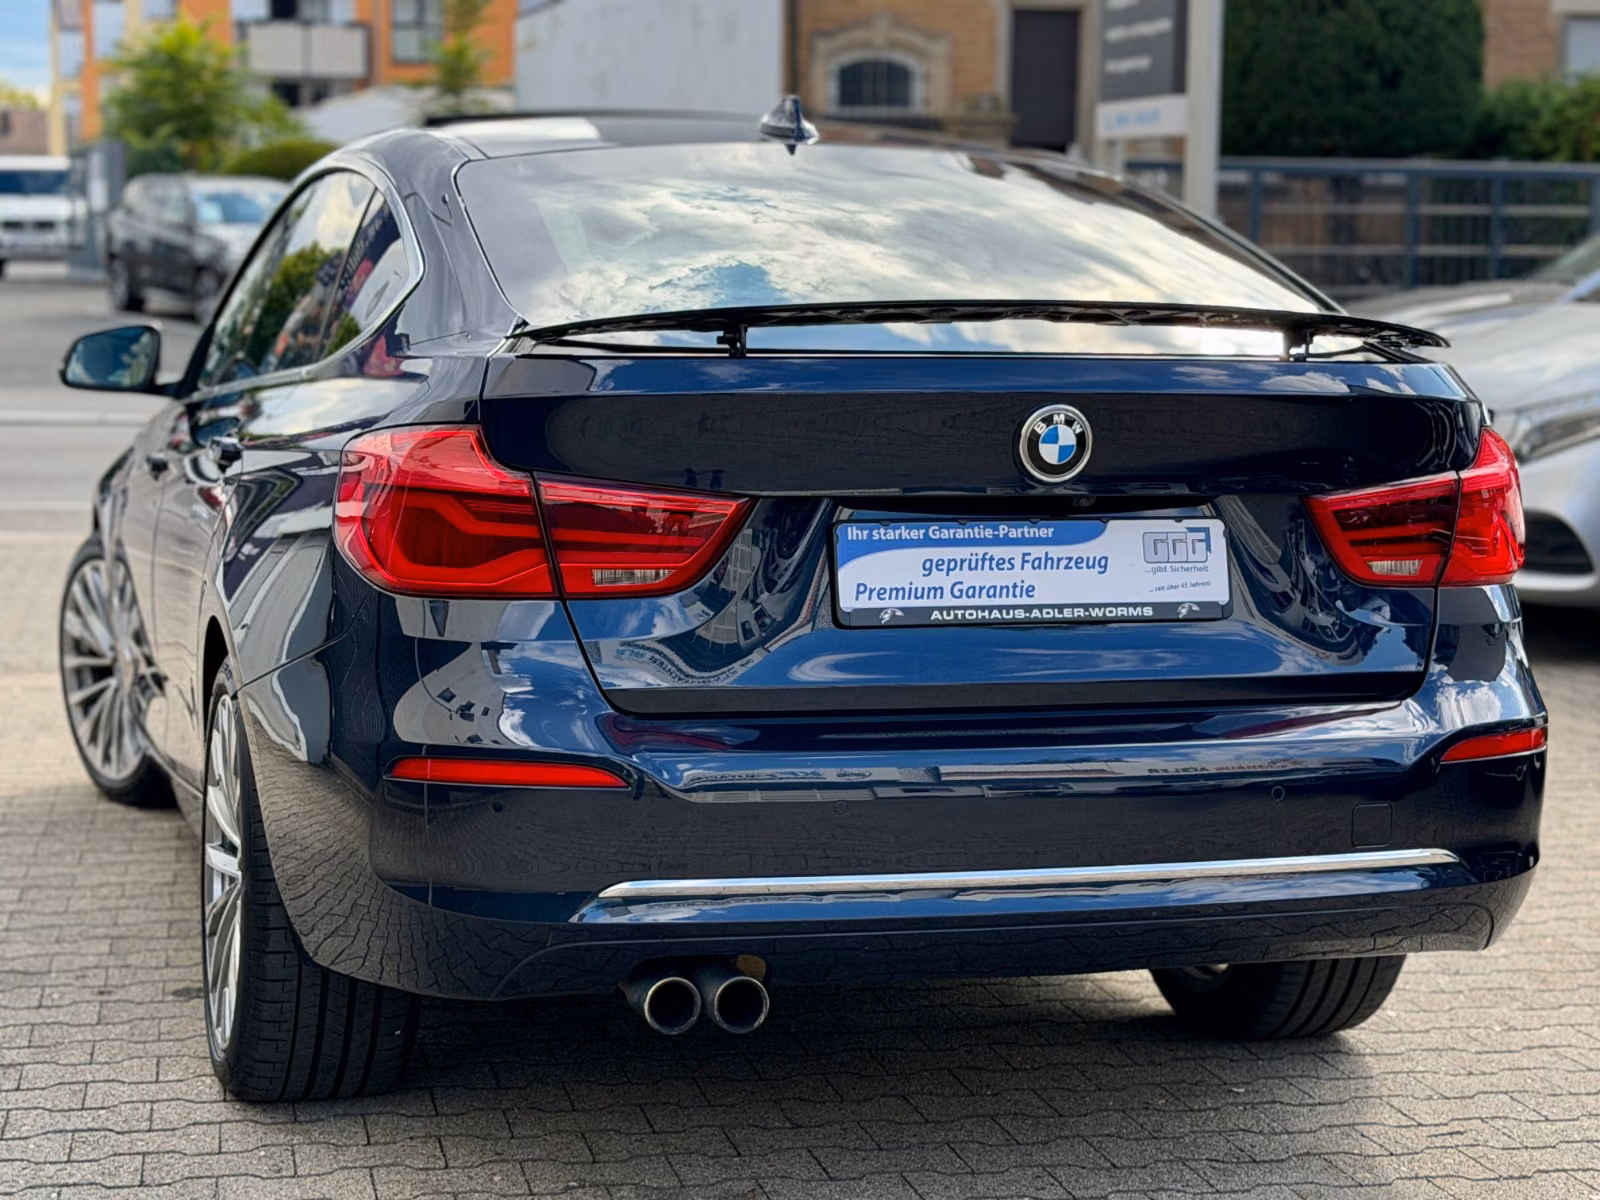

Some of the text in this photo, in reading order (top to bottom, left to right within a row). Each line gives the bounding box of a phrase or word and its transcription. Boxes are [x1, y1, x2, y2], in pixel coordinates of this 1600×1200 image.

[1033, 413, 1083, 434] BMW
[848, 525, 1054, 540] Ihr starker Garantie-Partner
[922, 551, 1109, 576] geprüftes Fahrzeug
[855, 580, 1036, 601] Premium Garantie
[930, 607, 1153, 620] AUTOHAUS-ADLER-WORMS
